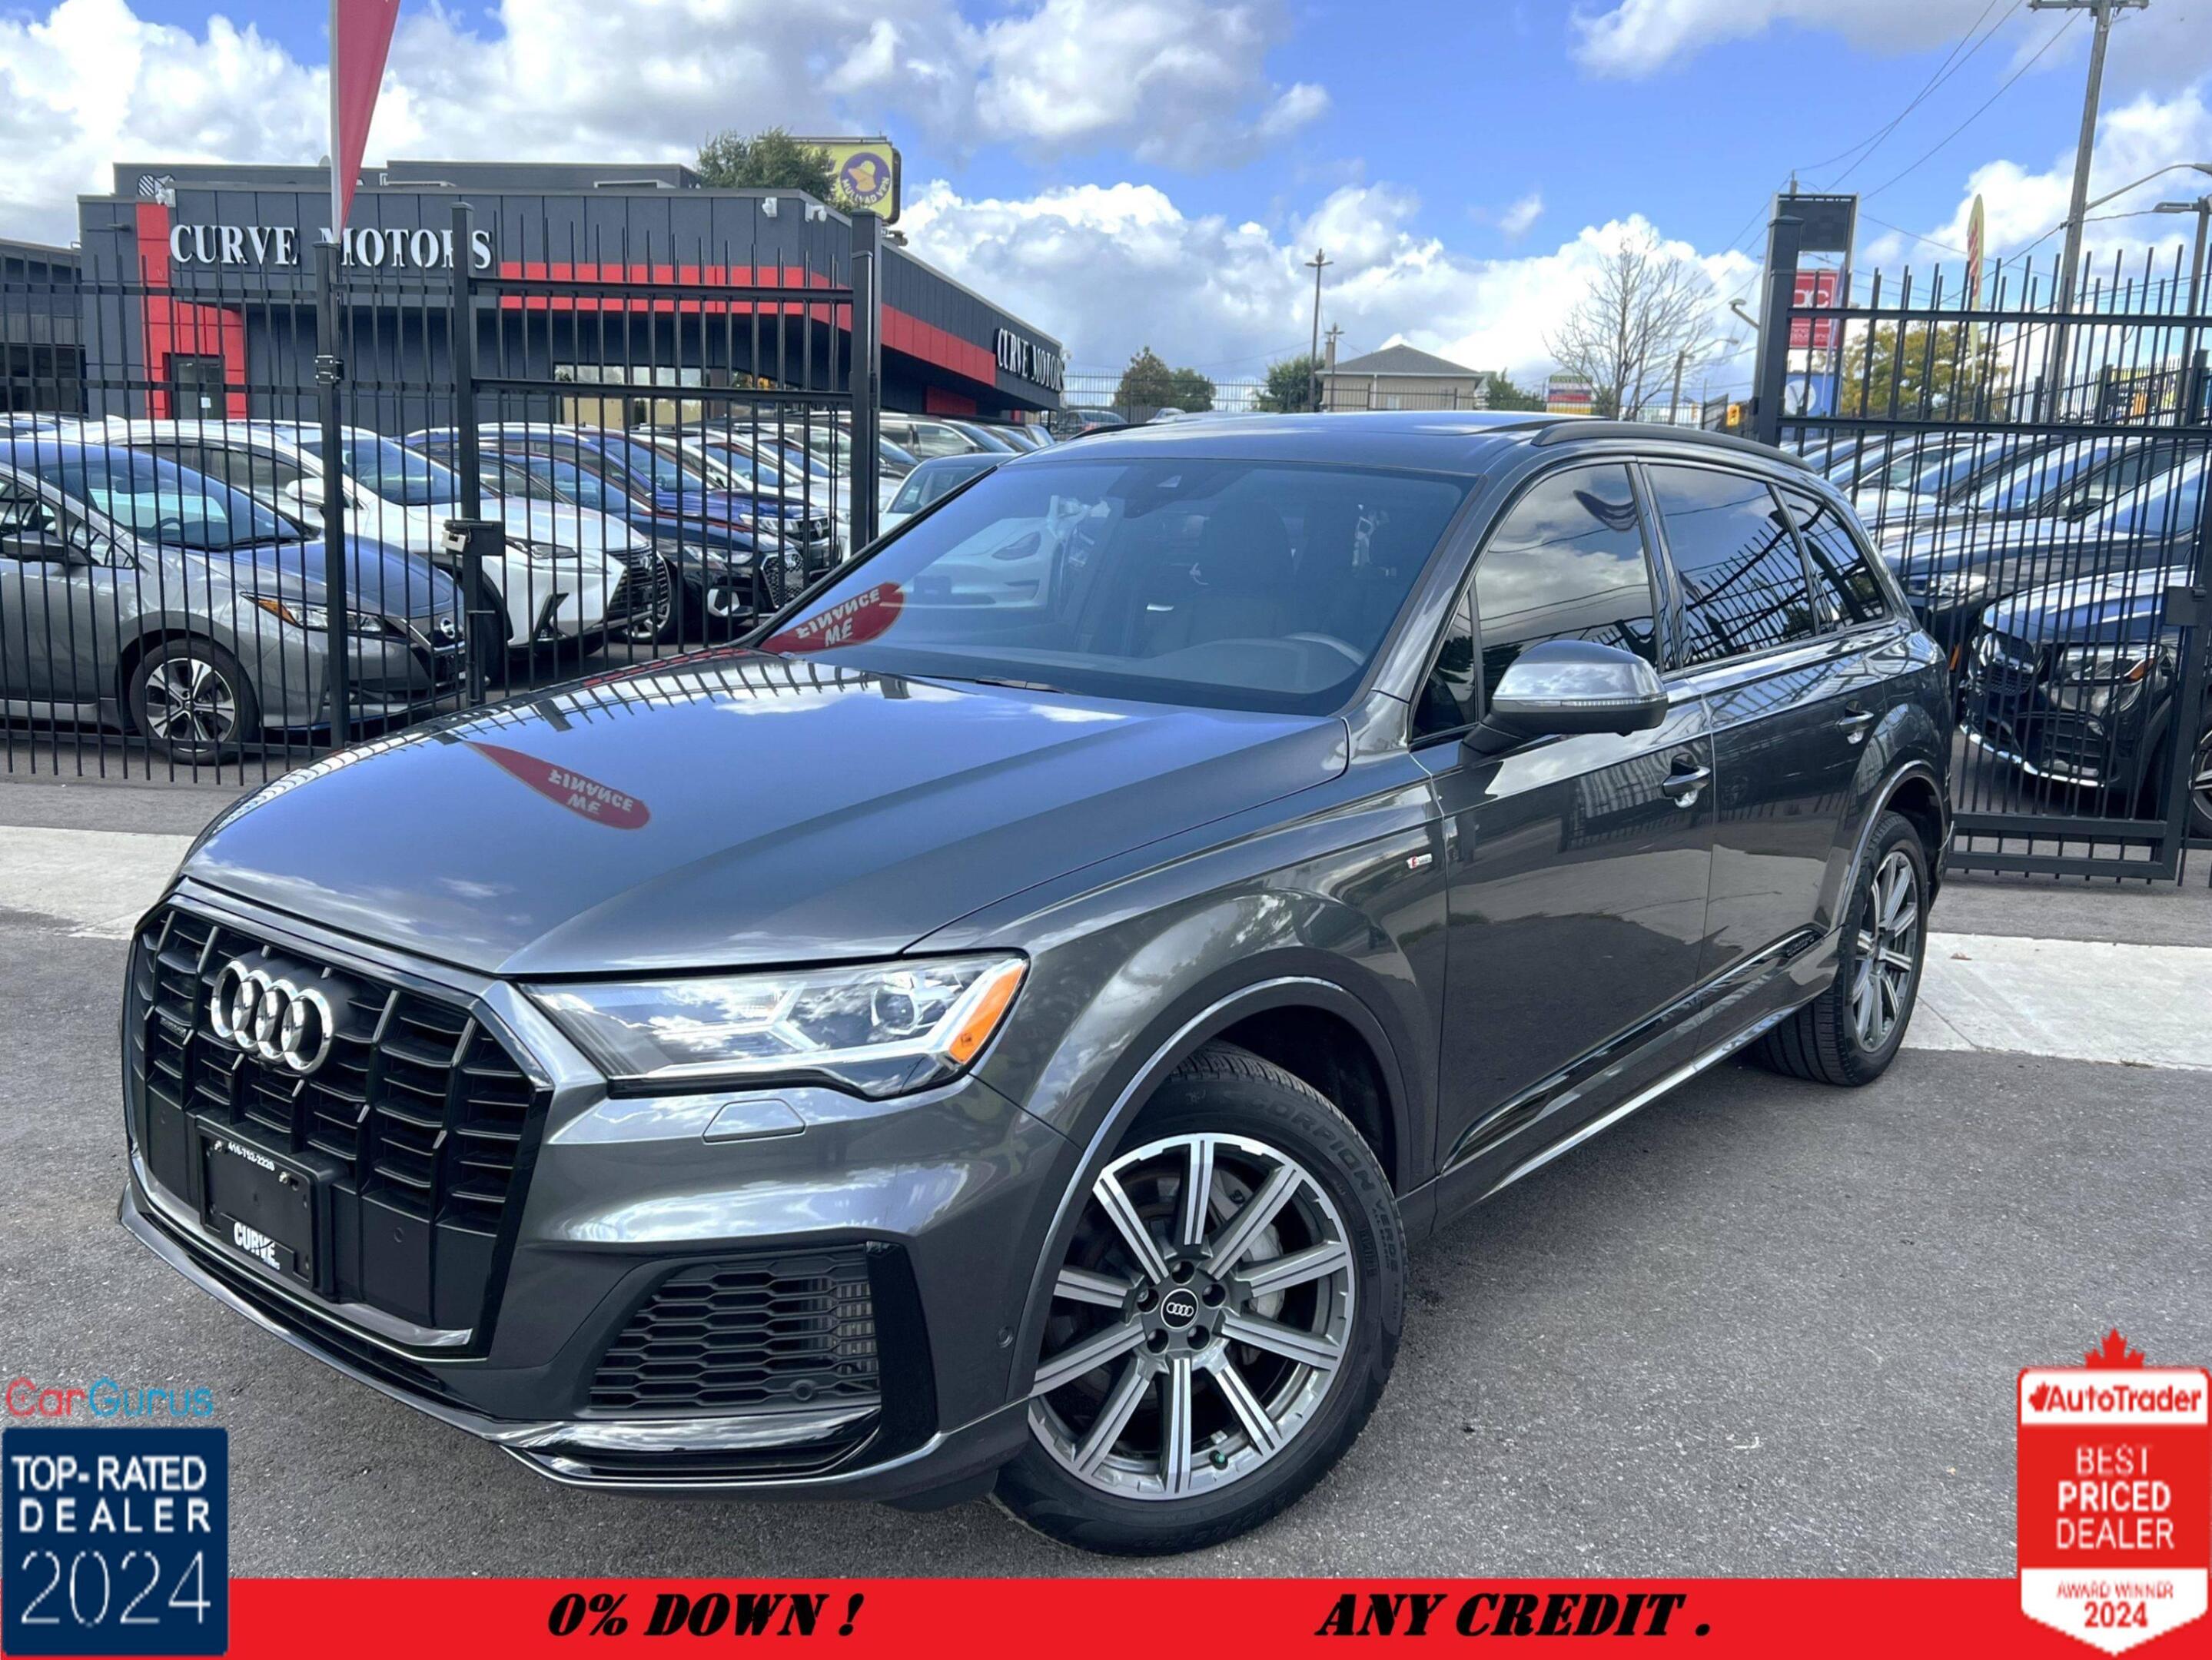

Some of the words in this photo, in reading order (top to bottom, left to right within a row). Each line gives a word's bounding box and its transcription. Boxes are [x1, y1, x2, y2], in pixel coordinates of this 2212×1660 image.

[169, 224, 298, 266] CURVE
[997, 328, 1029, 378] CURVE
[234, 1220, 276, 1263] CURVE
